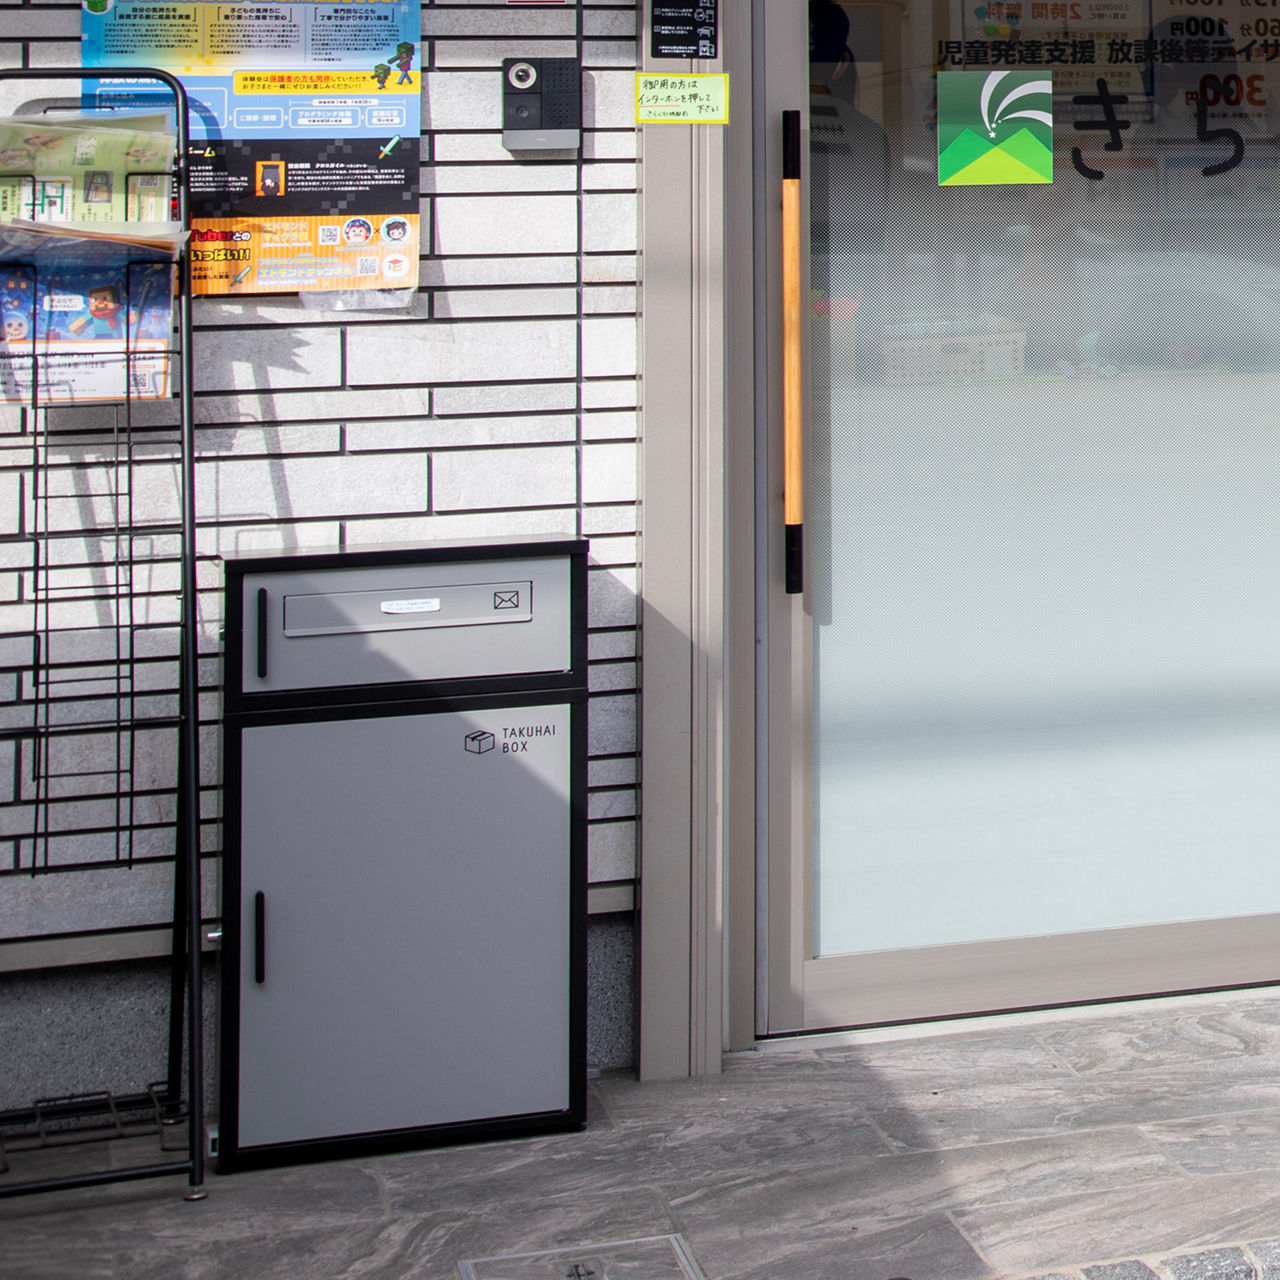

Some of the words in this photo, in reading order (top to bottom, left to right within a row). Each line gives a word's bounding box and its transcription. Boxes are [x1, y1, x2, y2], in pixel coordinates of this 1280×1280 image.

[937, 39, 1095, 67] 児童発達支援
[502, 725, 556, 738] TAKUHAI
[502, 741, 528, 753] BOX
